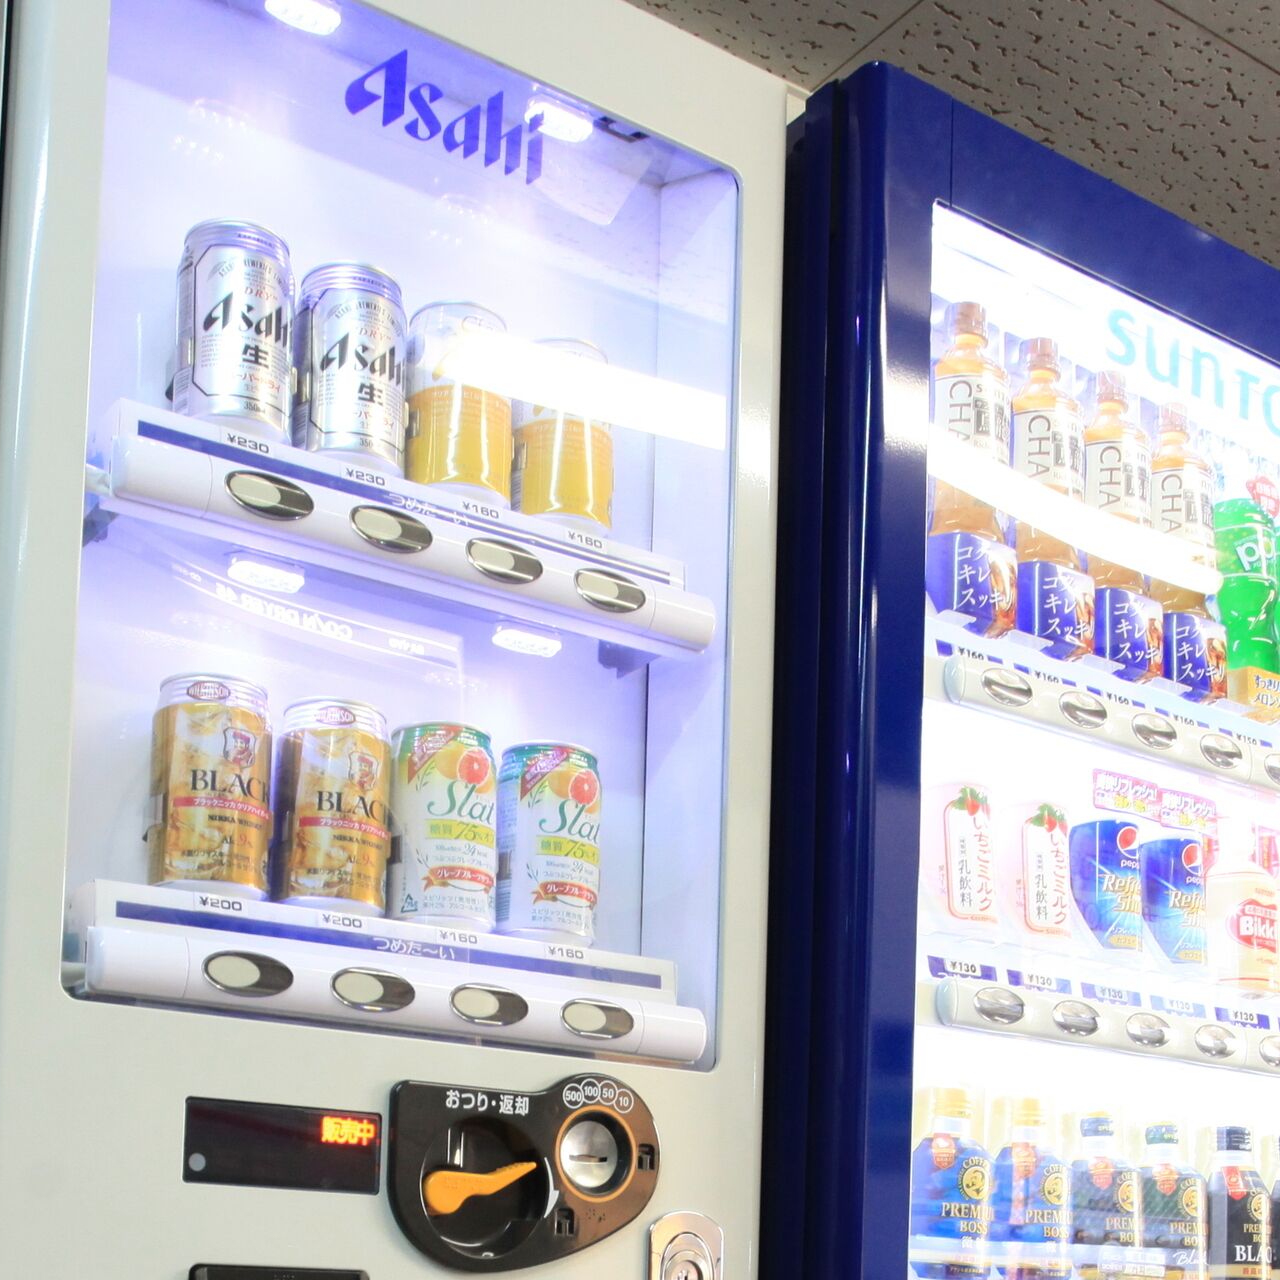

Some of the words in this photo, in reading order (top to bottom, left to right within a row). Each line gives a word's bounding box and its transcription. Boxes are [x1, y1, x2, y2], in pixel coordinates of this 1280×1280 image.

[345, 49, 544, 185] Asahi
[203, 292, 292, 348] Asah
[242, 343, 269, 369] 生
[321, 332, 403, 387] Asah
[358, 382, 383, 406] 生
[226, 433, 269, 455] ¥230
[1028, 414, 1051, 479] CHA
[345, 467, 386, 487] ¥230
[1098, 445, 1122, 508] CHA
[462, 500, 500, 520] ¥160
[567, 530, 603, 550] ¥160
[958, 562, 991, 584] キレ
[1044, 596, 1077, 615] キレ
[1115, 620, 1147, 639] キレ
[958, 646, 984, 662] ¥160
[1177, 641, 1208, 661] キレ
[1034, 670, 1059, 685] ¥160
[1106, 692, 1130, 706] ¥160
[1173, 713, 1195, 727] ¥160
[427, 780, 494, 825] Slat
[539, 799, 600, 842] Slat
[973, 816, 993, 912] いちごミルク
[958, 859, 972, 908] 乳飲料
[1050, 833, 1068, 925] いちごミルク
[199, 897, 242, 912] ¥200
[1035, 873, 1048, 921] 乳飲料
[322, 913, 363, 929] ¥200
[439, 929, 478, 944] ¥160
[548, 944, 585, 960] ¥160
[950, 961, 977, 974] ¥130
[1027, 974, 1052, 986] ¥130
[1100, 987, 1123, 999] ¥130
[1233, 1010, 1255, 1022] ¥130
[445, 1089, 530, 1116] おつり・返却
[565, 1090, 582, 1101] 500
[584, 1085, 599, 1097] 100
[602, 1088, 614, 1098] 50
[619, 1096, 629, 1107] 10
[322, 1117, 375, 1145] 販売中
[960, 1220, 988, 1235] BOSS
